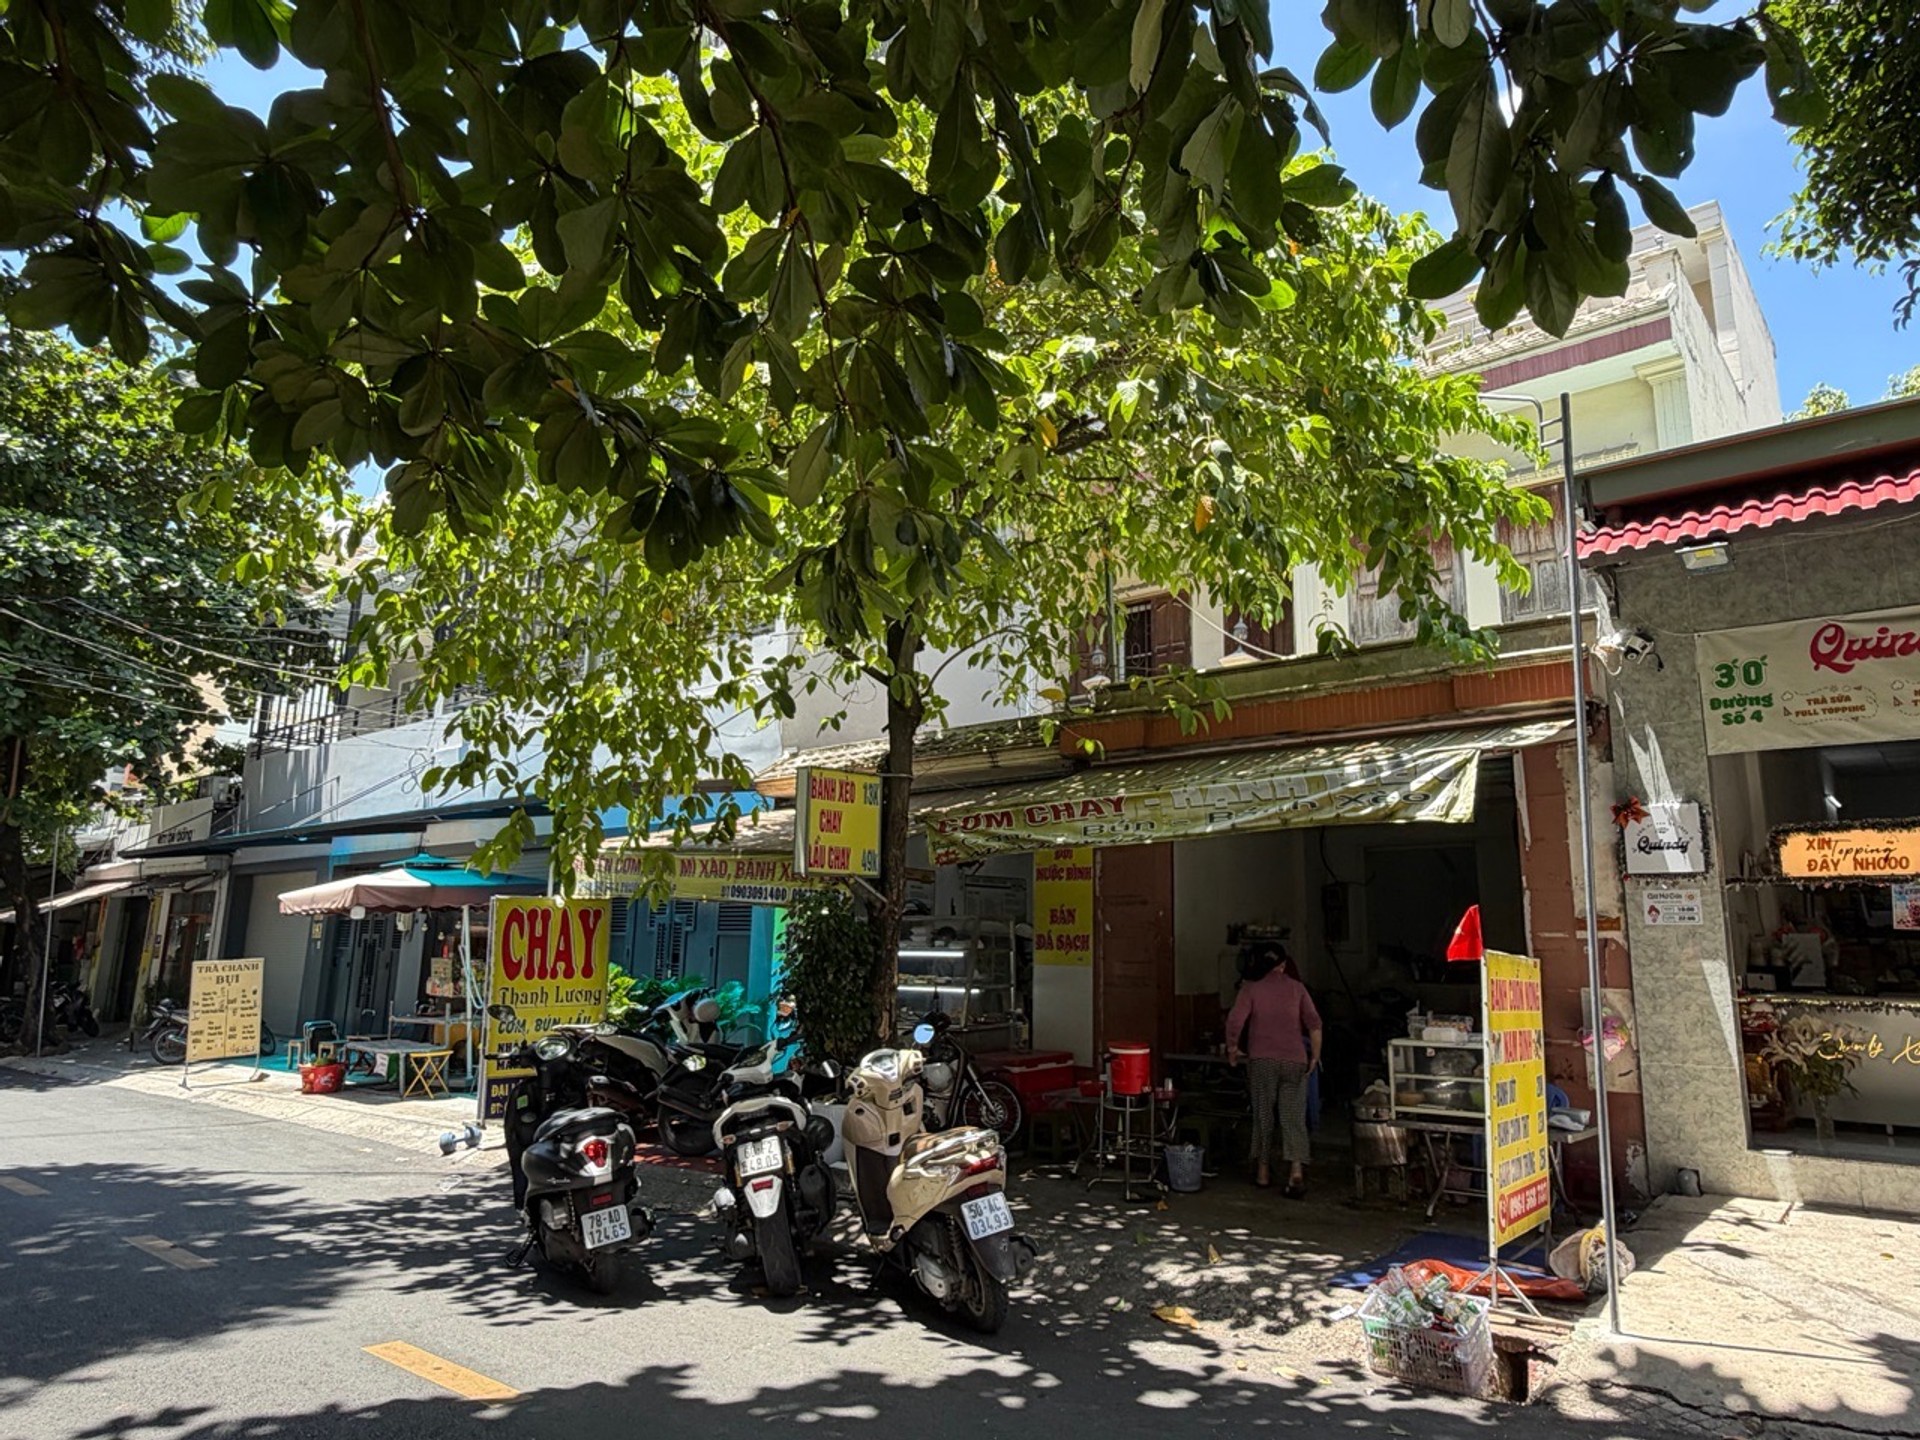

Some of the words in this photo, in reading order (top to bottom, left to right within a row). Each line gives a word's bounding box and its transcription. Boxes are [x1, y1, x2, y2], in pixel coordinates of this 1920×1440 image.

[1810, 623, 1920, 674] Quin
[1714, 657, 1765, 689] 30
[1710, 693, 1774, 711] Đường
[1795, 708, 1819, 718] FULL
[1821, 704, 1867, 715] TOPPING
[1806, 693, 1828, 707] TRÀ
[1721, 707, 1746, 726] Số
[1750, 710, 1764, 723] 4
[810, 771, 837, 802] BÁNH
[936, 809, 1015, 834] CƠM
[1024, 796, 1126, 827] CHAY
[1170, 776, 1309, 810] HẠNH
[819, 808, 843, 834] CHAY
[808, 835, 826, 869] LẨU
[828, 845, 851, 872] CHAY
[1636, 835, 1691, 855] Quindy
[1831, 839, 1897, 863] Topping
[734, 857, 777, 881] BÁNH
[1049, 903, 1077, 925] BÁN
[501, 906, 602, 981] CHAY
[1035, 930, 1054, 951] ĐÁ
[1056, 933, 1090, 955] SẠCH
[215, 974, 240, 987] BỤI
[499, 985, 549, 1006] Thanh
[555, 985, 602, 1006] Lương
[589, 1223, 627, 1246] 124.65
[970, 1212, 1009, 1235] 034.93
